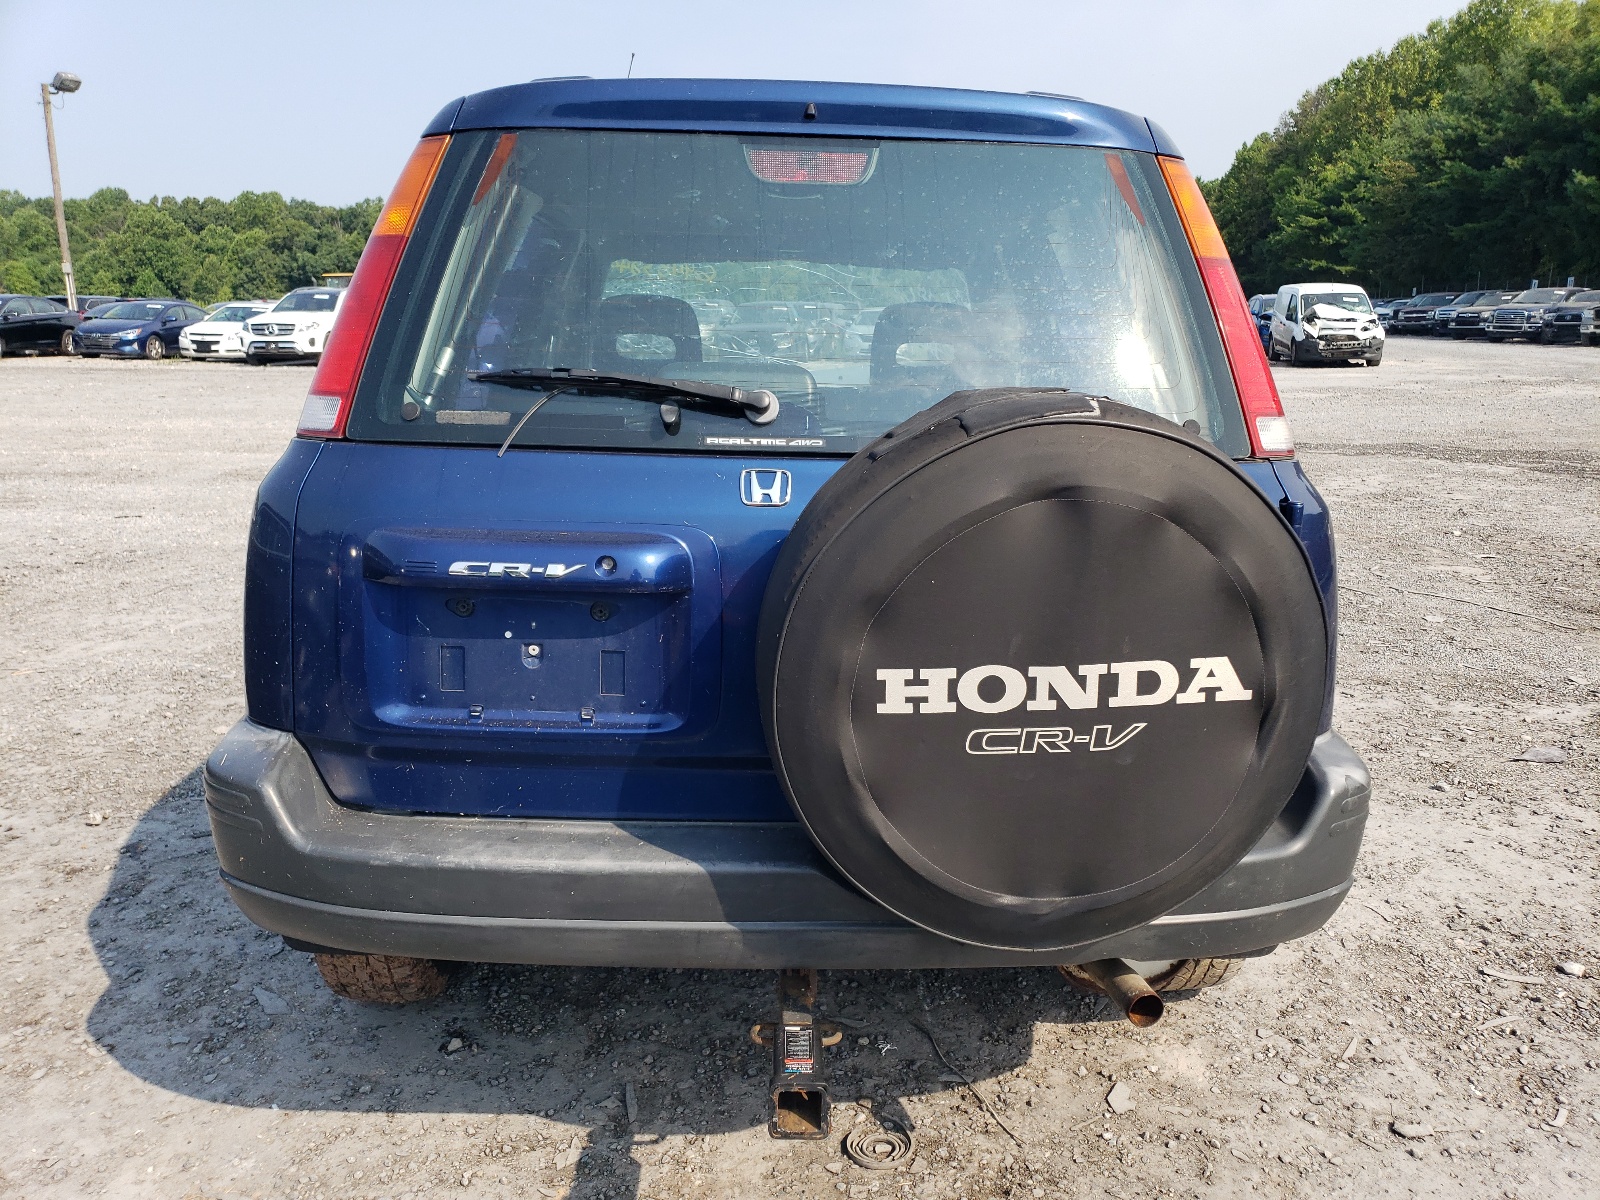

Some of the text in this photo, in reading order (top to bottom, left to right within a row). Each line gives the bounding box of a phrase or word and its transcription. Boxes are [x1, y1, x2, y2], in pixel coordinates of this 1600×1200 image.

[448, 561, 587, 578] CR-V
[876, 656, 1253, 714] HONDA
[965, 722, 1148, 755] CR-V
